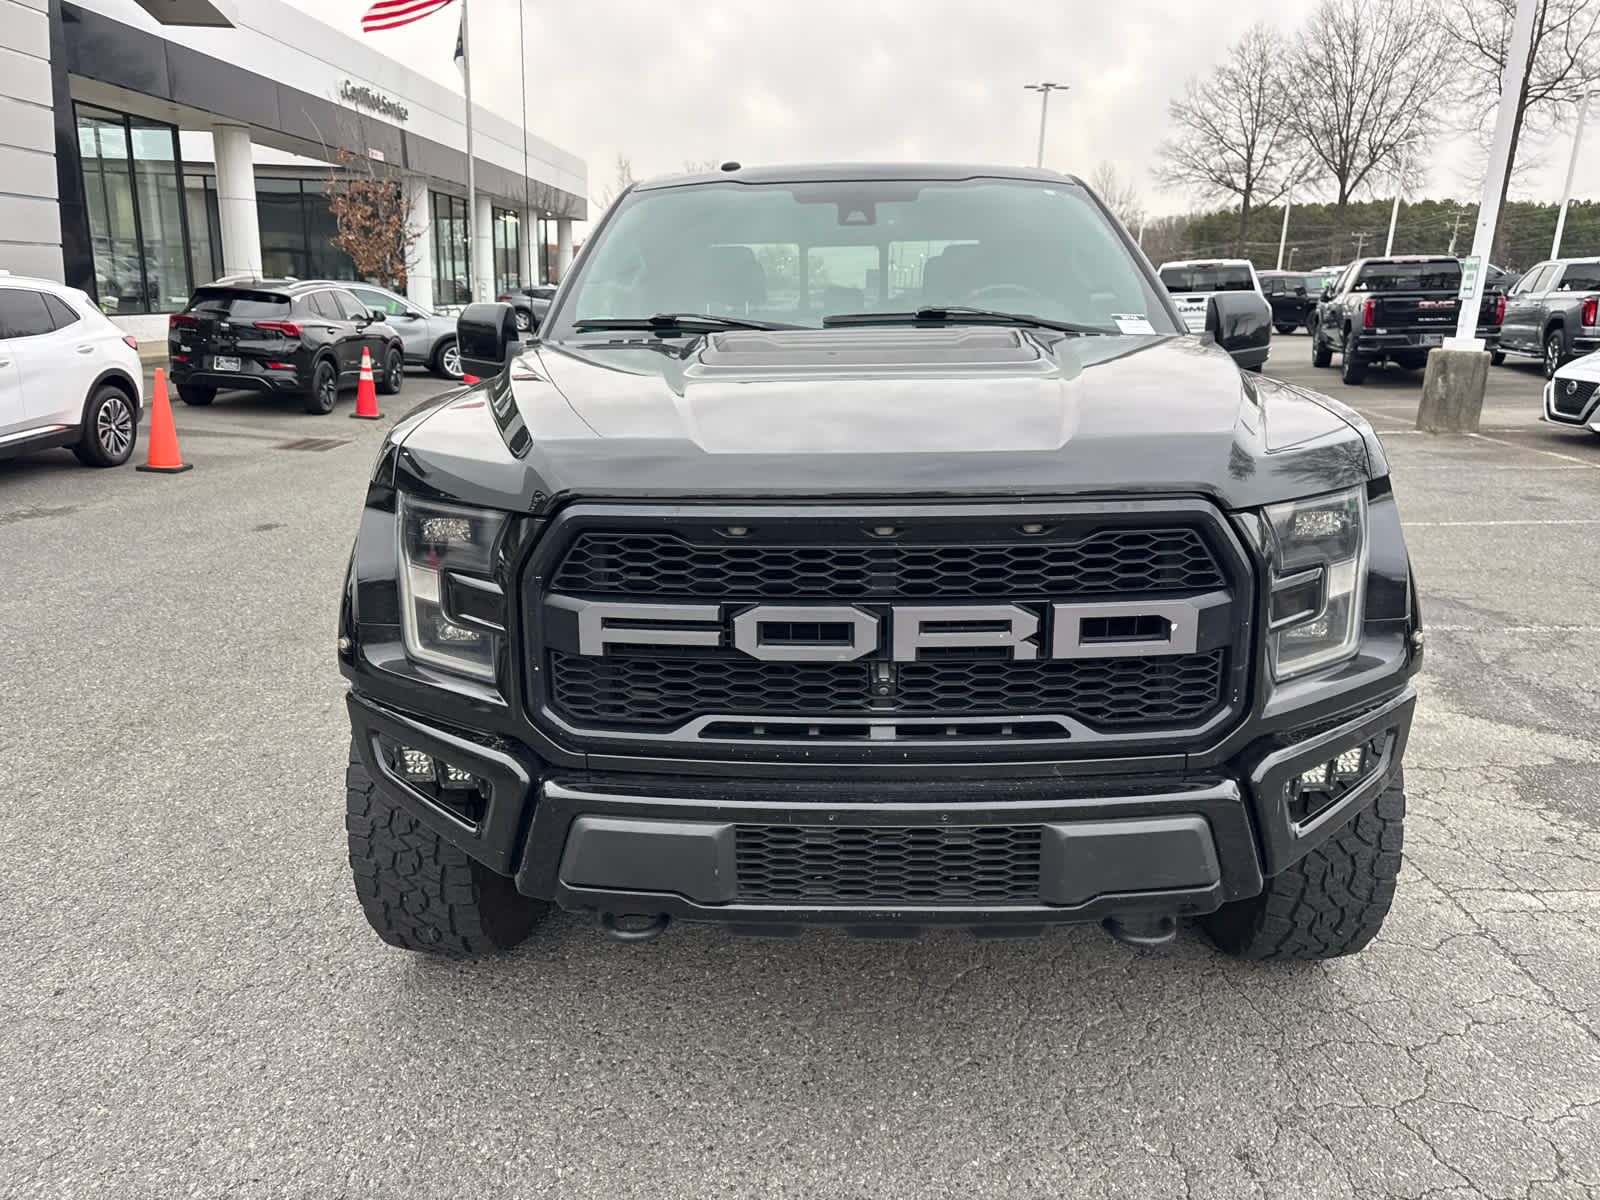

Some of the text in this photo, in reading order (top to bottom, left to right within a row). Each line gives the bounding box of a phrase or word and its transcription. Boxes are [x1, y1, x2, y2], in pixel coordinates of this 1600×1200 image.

[379, 95, 408, 120] Service
[1418, 300, 1456, 309] GMC
[578, 601, 1199, 662] FORD
